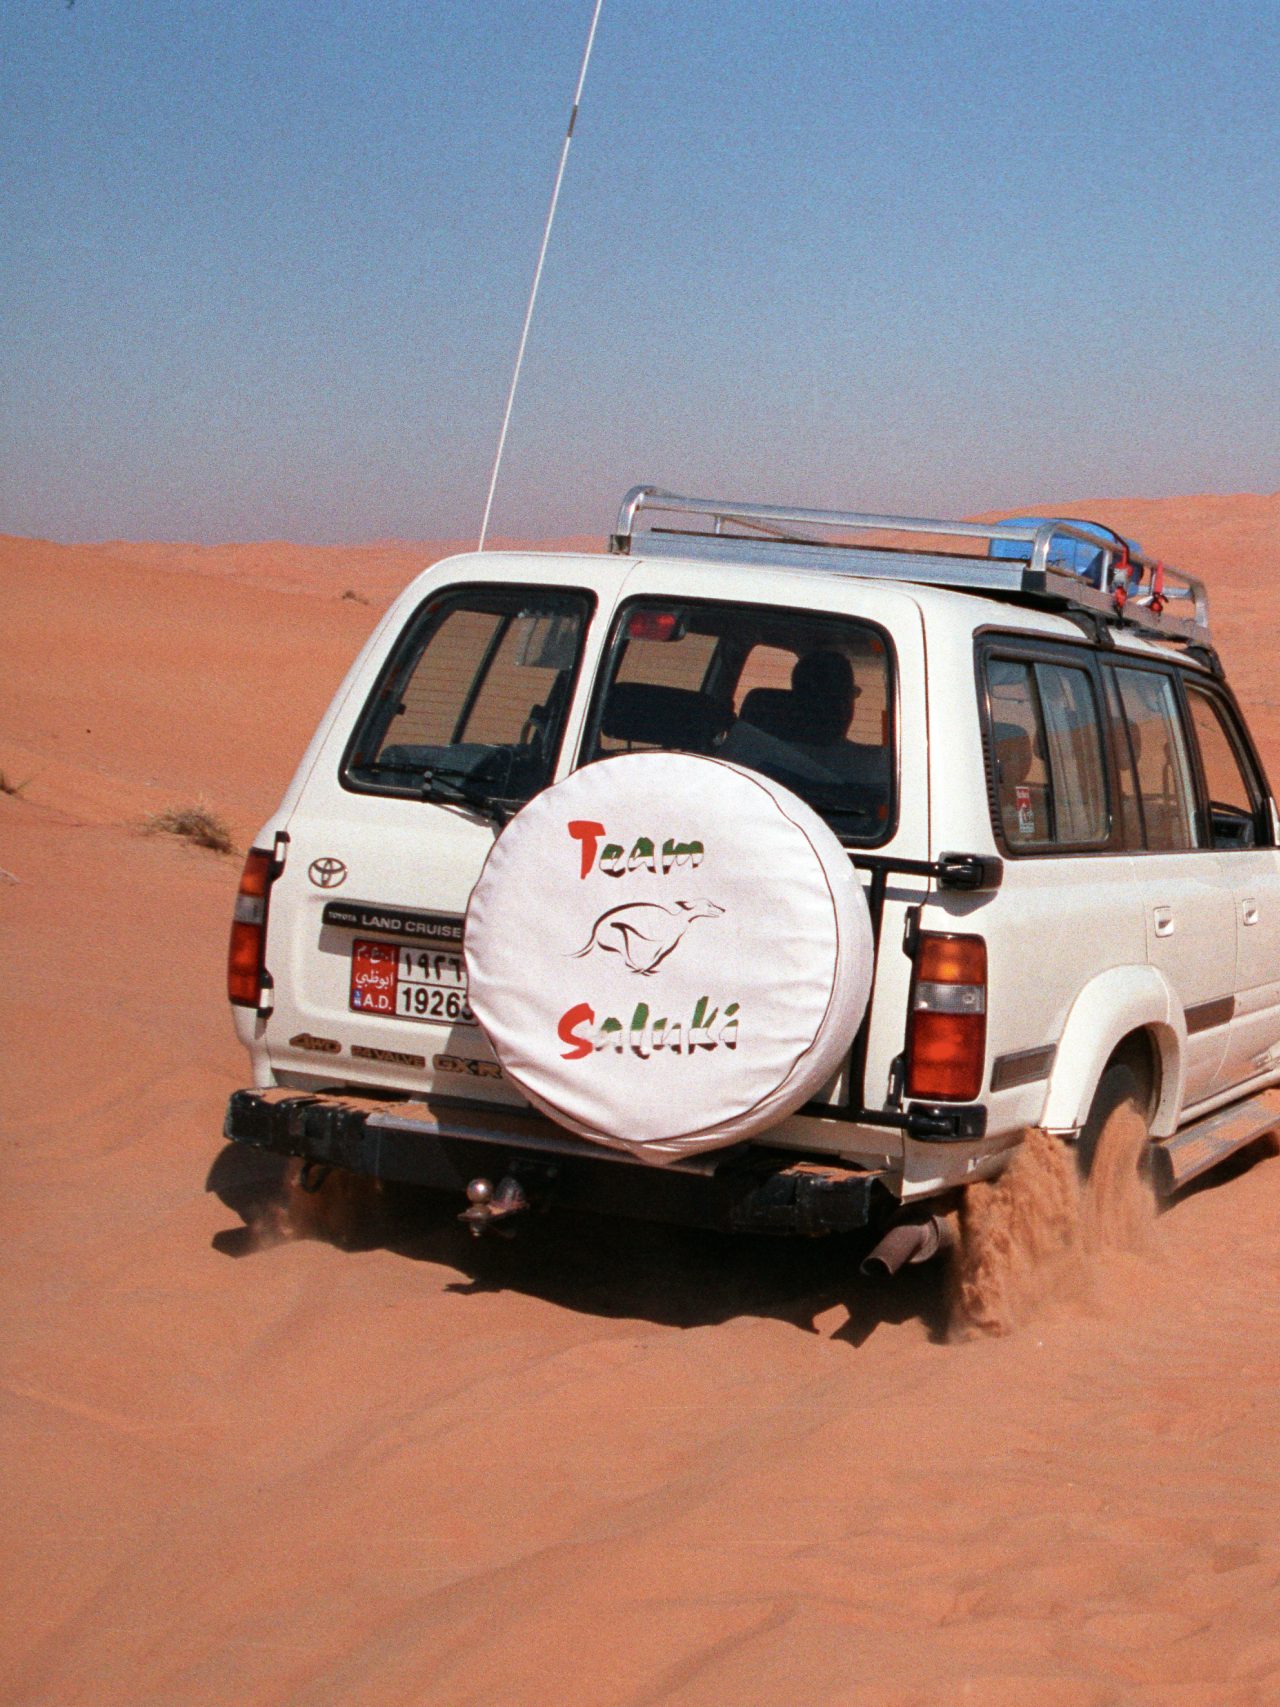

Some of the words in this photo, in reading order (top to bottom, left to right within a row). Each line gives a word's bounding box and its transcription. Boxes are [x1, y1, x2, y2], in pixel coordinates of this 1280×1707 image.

[568, 820, 705, 880] Team
[328, 911, 358, 923] TOYOTA
[361, 914, 402, 930] LAND
[405, 921, 462, 939] CRUISE
[405, 953, 463, 982] ١٩٢٦
[363, 993, 392, 1010] A.D.
[557, 995, 740, 1060] Saluki
[372, 1048, 424, 1067] VALVE
